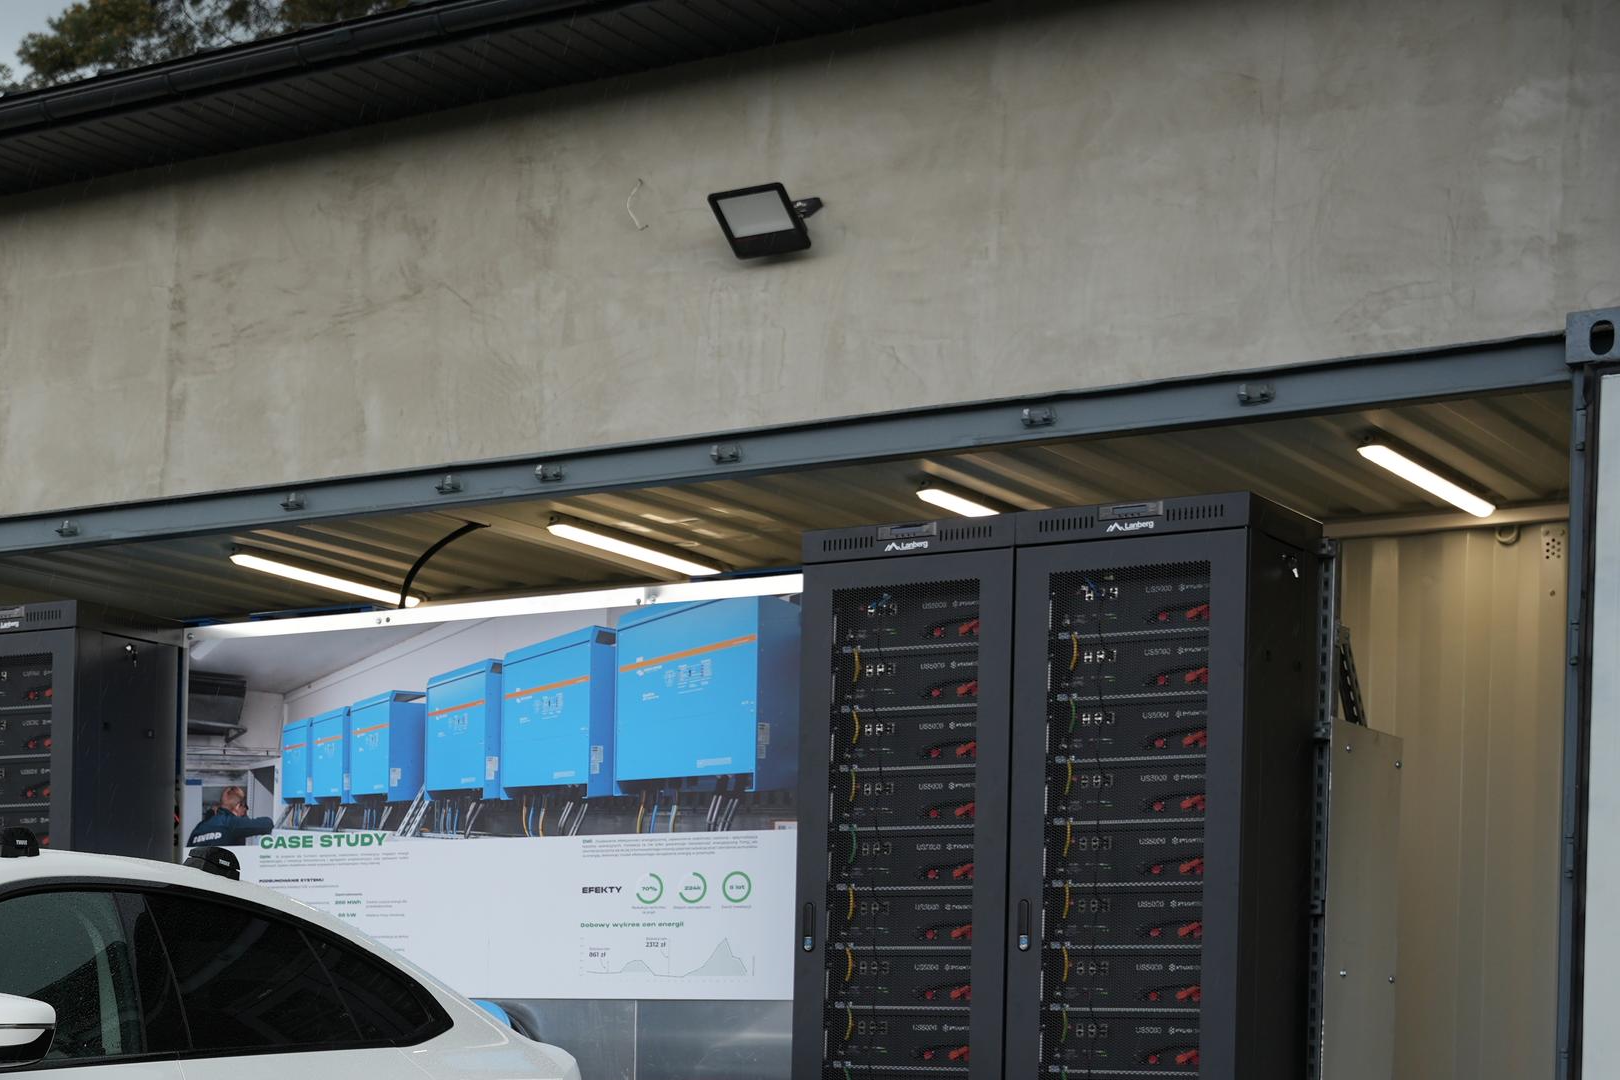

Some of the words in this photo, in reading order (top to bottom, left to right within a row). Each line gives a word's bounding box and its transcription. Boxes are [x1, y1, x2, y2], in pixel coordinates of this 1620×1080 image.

[1125, 520, 1154, 530] Lanberg
[900, 540, 929, 550] Lanberg
[260, 835, 314, 850] CASE
[319, 833, 388, 848] STUDY
[582, 886, 623, 894] EFEKTY
